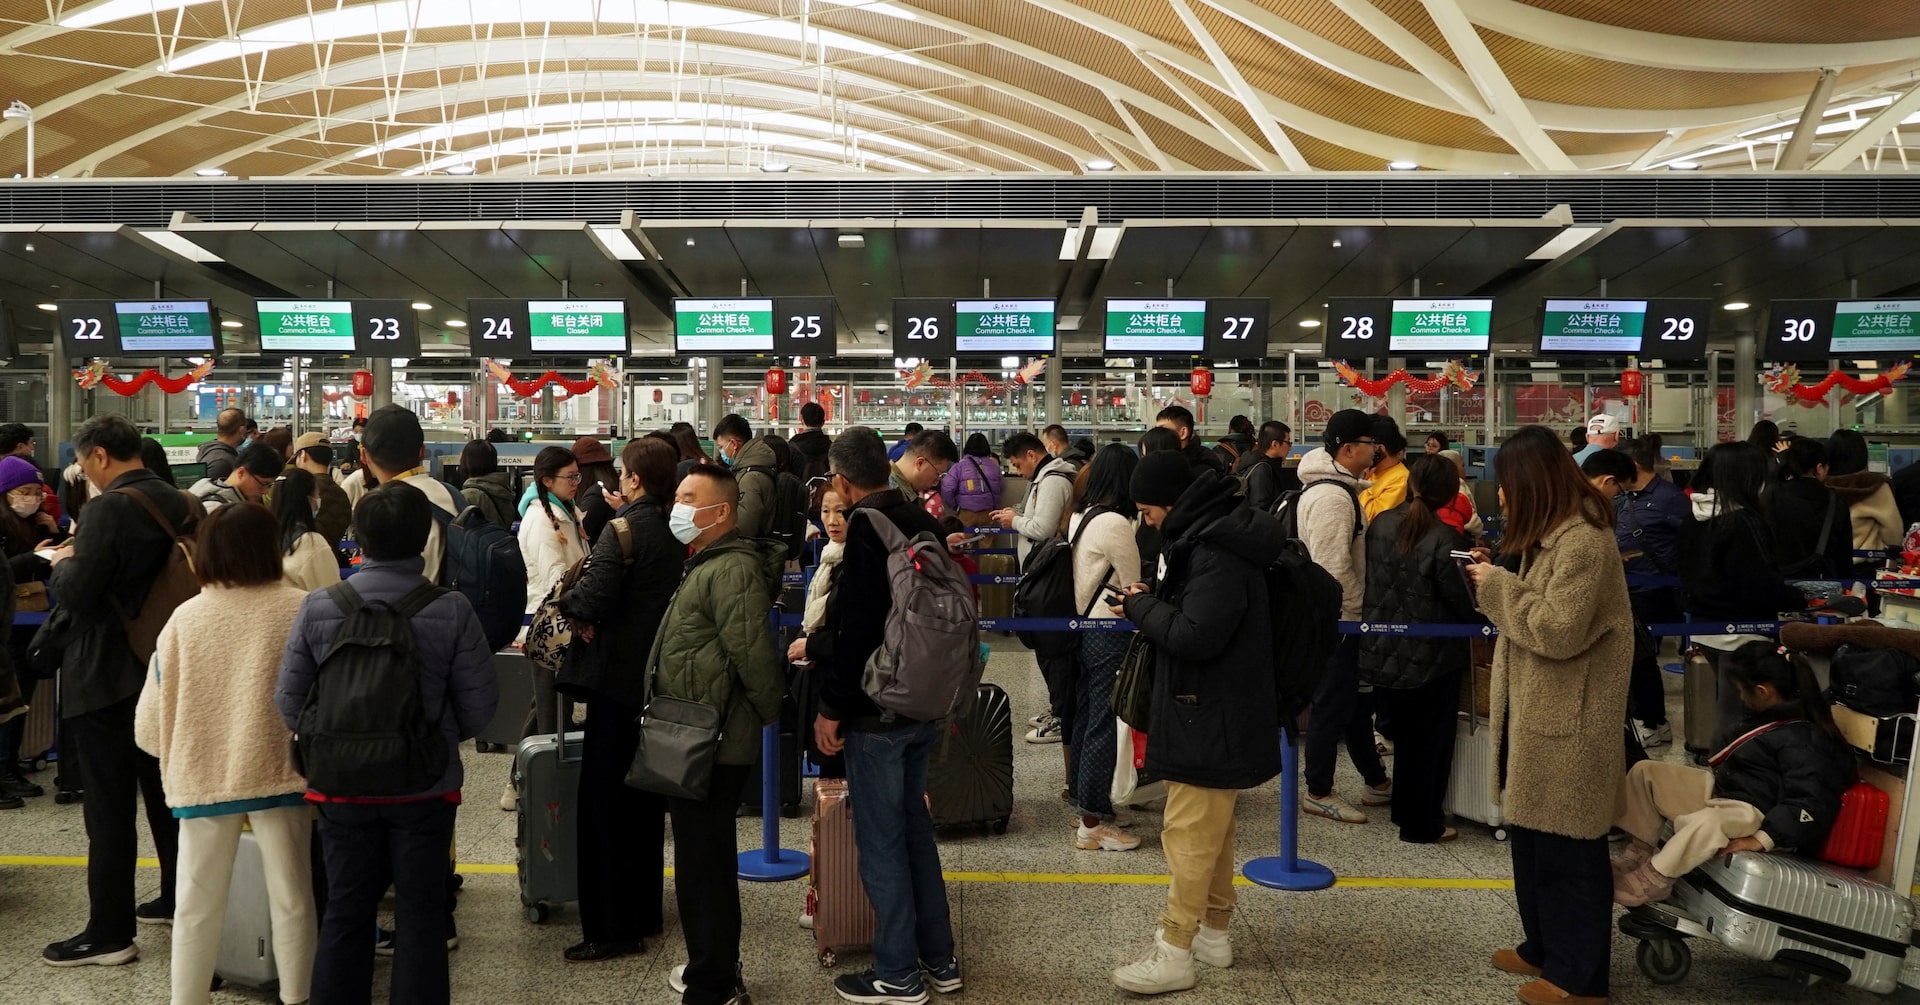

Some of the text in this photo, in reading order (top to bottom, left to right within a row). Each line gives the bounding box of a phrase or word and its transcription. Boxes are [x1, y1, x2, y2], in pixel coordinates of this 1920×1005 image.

[139, 315, 189, 327] 公共柜台
[281, 315, 331, 327] 公共柜台
[551, 314, 603, 328] 柜台关闭
[699, 314, 750, 326] 公共柜台
[980, 314, 1031, 327] 公共柜台
[1130, 314, 1182, 327] 公共柜台
[1415, 314, 1467, 326] 公共柜台
[1568, 314, 1621, 327] 公共柜台
[1858, 315, 1912, 327] 公共柜台
[72, 318, 104, 340] 22
[370, 318, 400, 340] 23
[482, 318, 513, 340] 24
[696, 326, 754, 334] Common Check-in
[790, 316, 822, 338] 25
[907, 318, 938, 339] 26
[1222, 317, 1254, 339] 27
[1341, 317, 1374, 339] 28
[1410, 326, 1470, 334] Common Check-in
[1661, 318, 1694, 340] 29
[1781, 319, 1815, 341] 30
[1462, 399, 1483, 408] 2024
